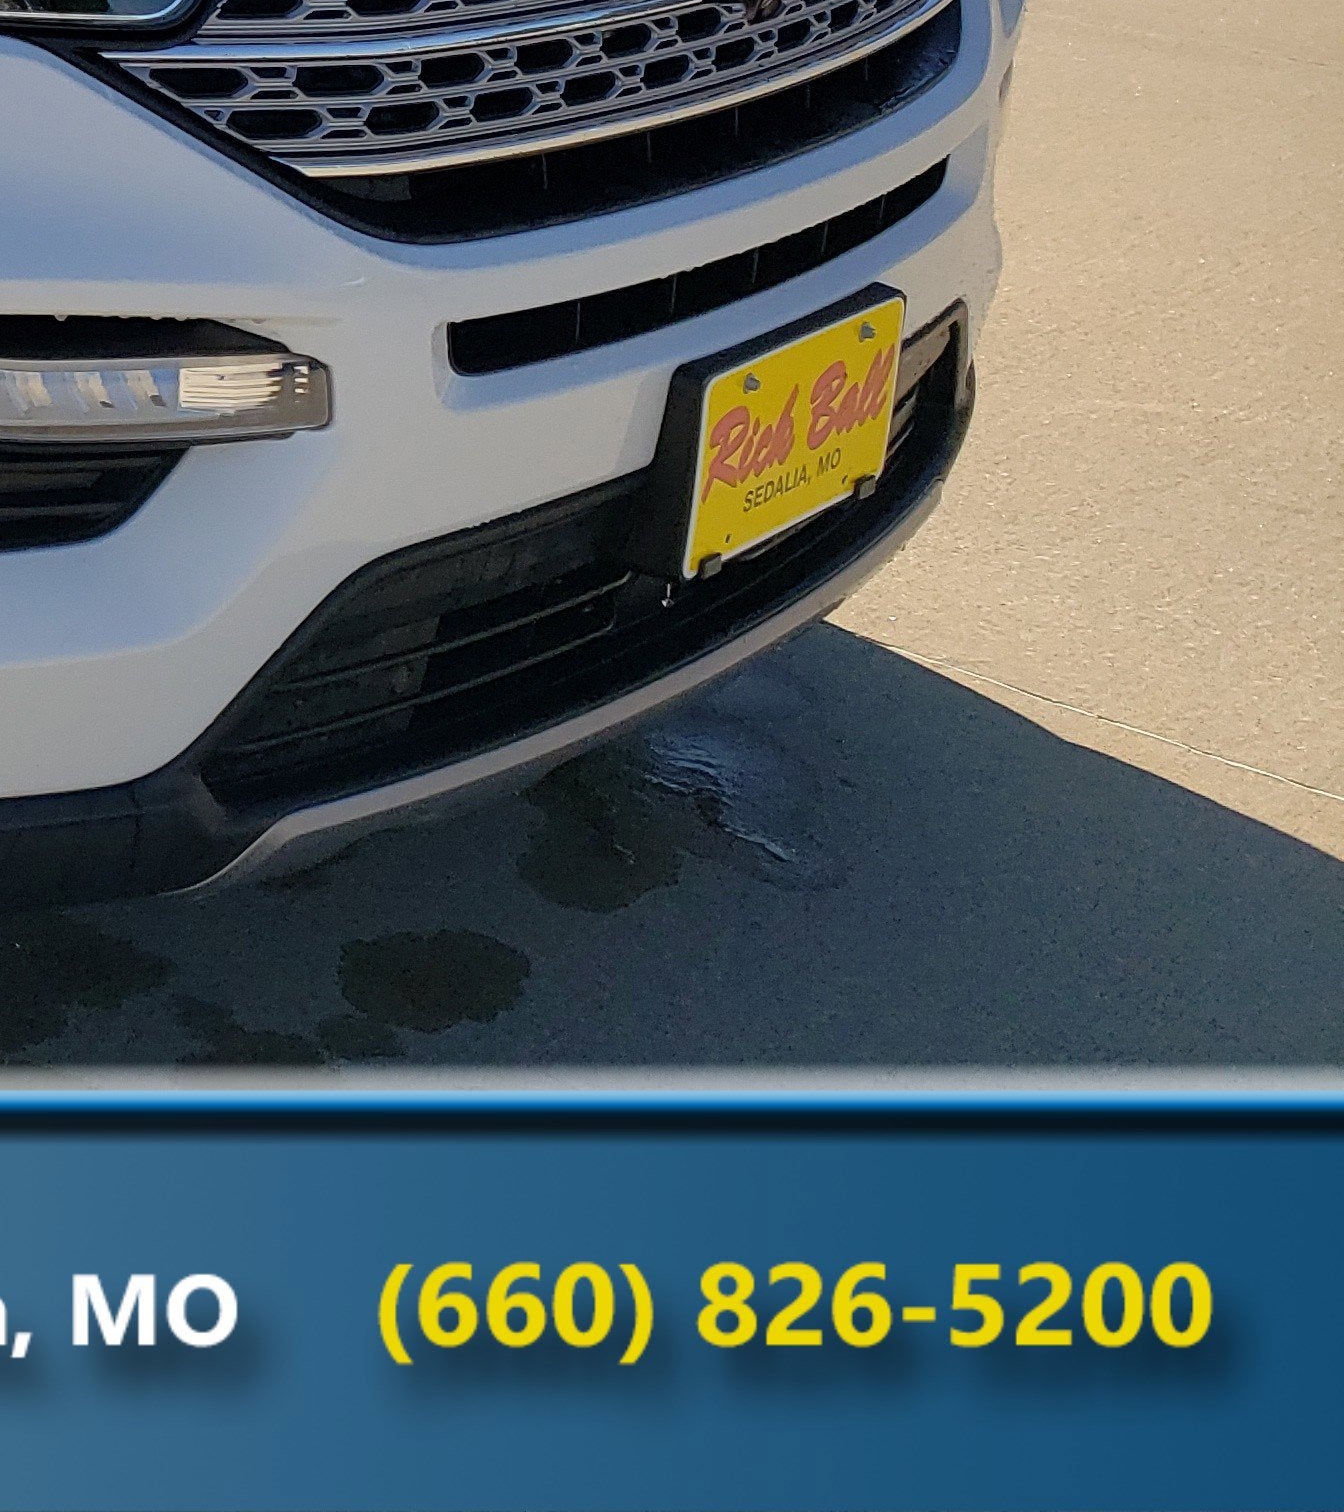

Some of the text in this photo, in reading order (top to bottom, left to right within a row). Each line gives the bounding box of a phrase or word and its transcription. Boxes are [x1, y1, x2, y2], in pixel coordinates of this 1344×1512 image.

[700, 342, 896, 505] Rick Ball
[742, 447, 843, 514] SEDALIA, MO
